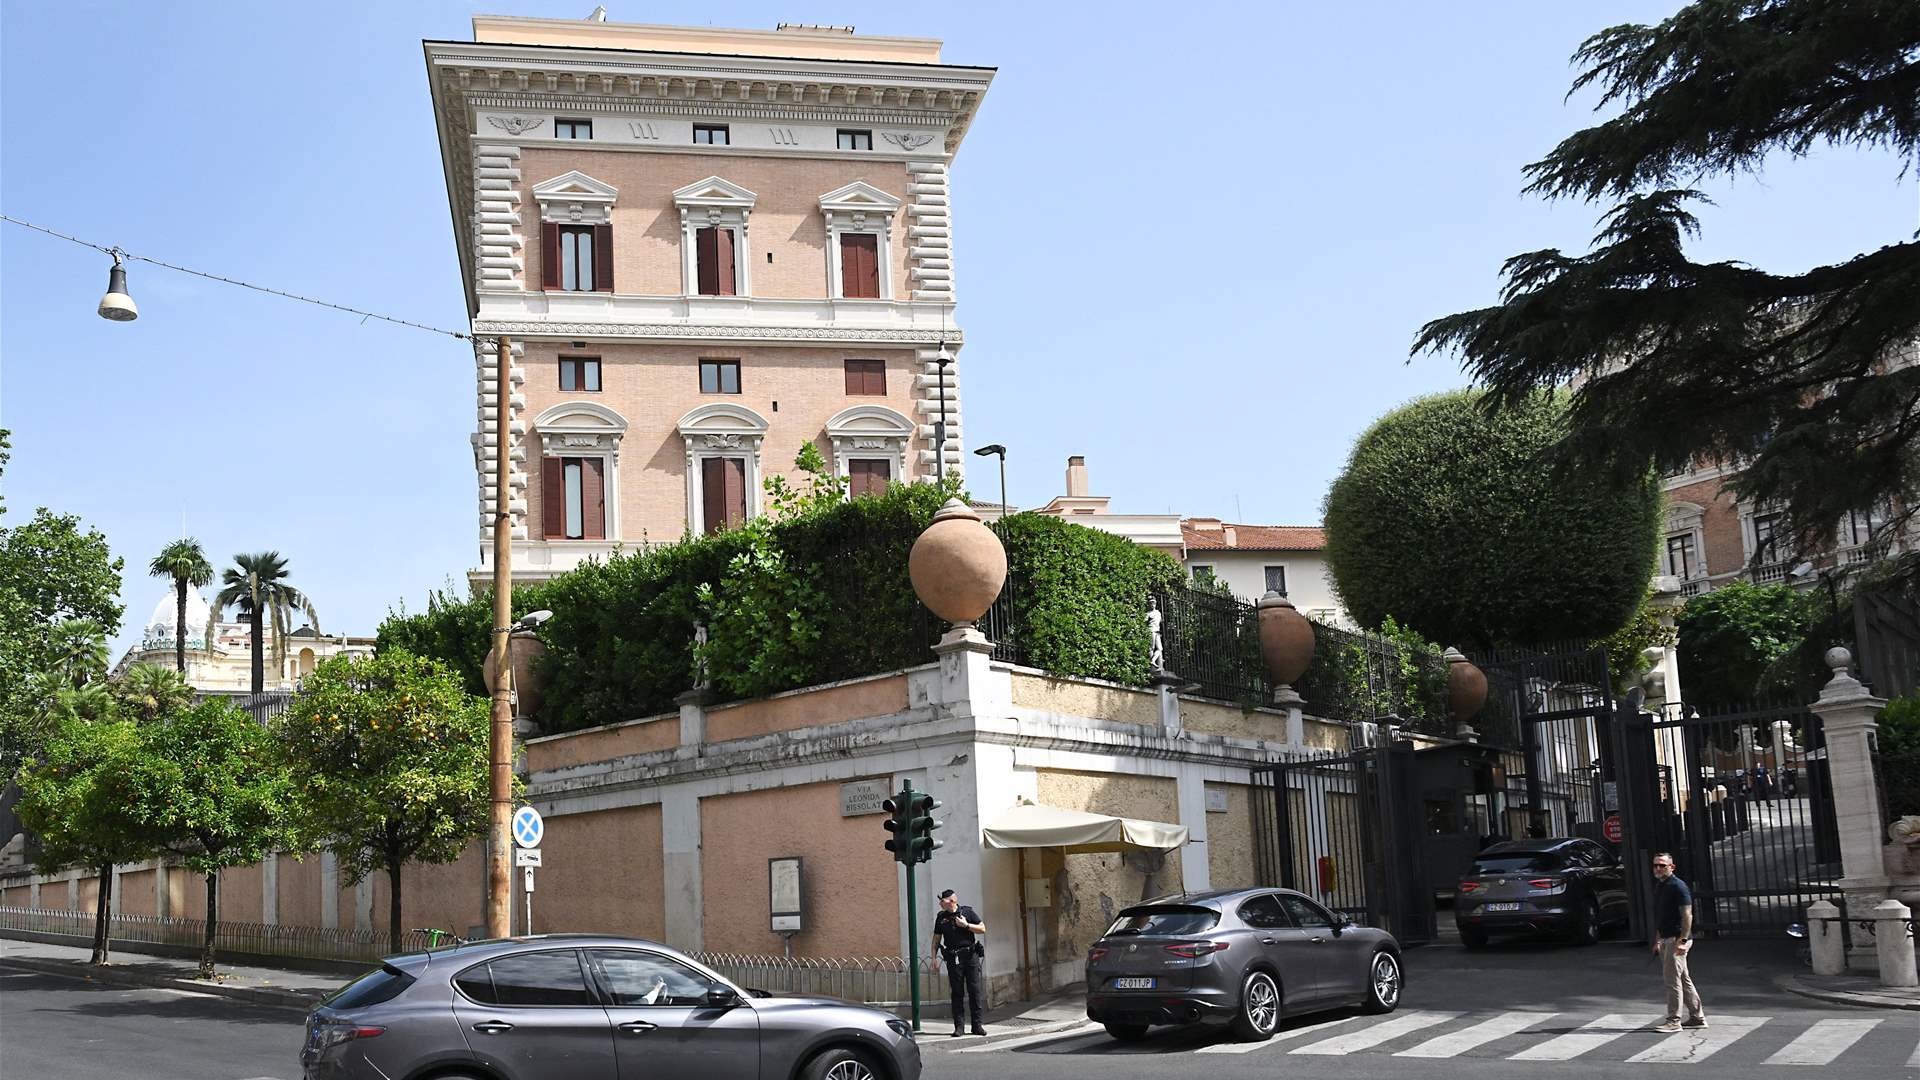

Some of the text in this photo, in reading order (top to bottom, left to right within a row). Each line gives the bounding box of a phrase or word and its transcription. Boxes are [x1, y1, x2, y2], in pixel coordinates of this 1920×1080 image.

[857, 785, 872, 793] VIA
[848, 793, 881, 803] LEONIDA
[846, 801, 883, 812] BISSOLAT
